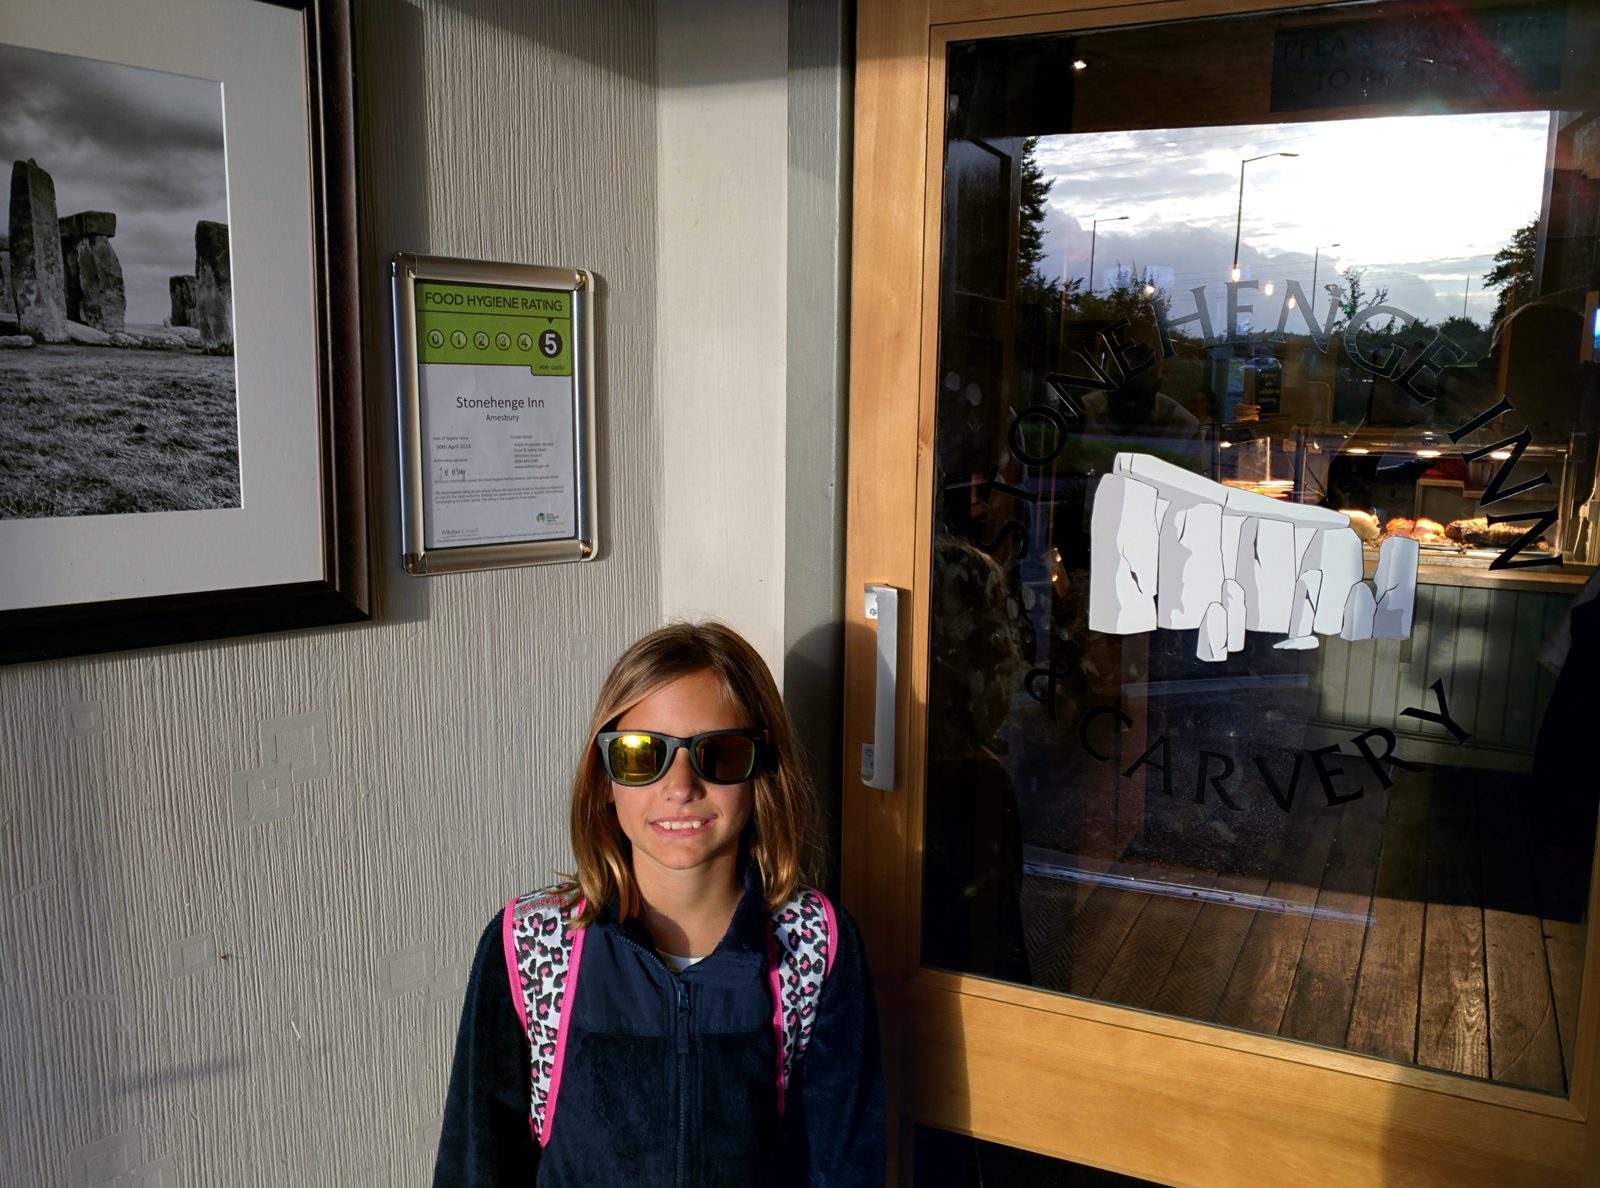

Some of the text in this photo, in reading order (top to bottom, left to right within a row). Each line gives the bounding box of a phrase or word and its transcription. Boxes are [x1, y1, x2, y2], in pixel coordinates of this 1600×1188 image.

[425, 292, 563, 311] FOOD HYGIENE RATING
[431, 333, 440, 345] 0
[478, 334, 485, 346] 2
[500, 335, 507, 347] 3
[521, 336, 528, 347] 4
[544, 333, 558, 355] 5
[456, 396, 545, 410] Stonehenge Inn
[485, 413, 520, 423] Amesbury
[976, 279, 1564, 570] STONEHENGE INN
[1024, 655, 1473, 814] & CARVERY
